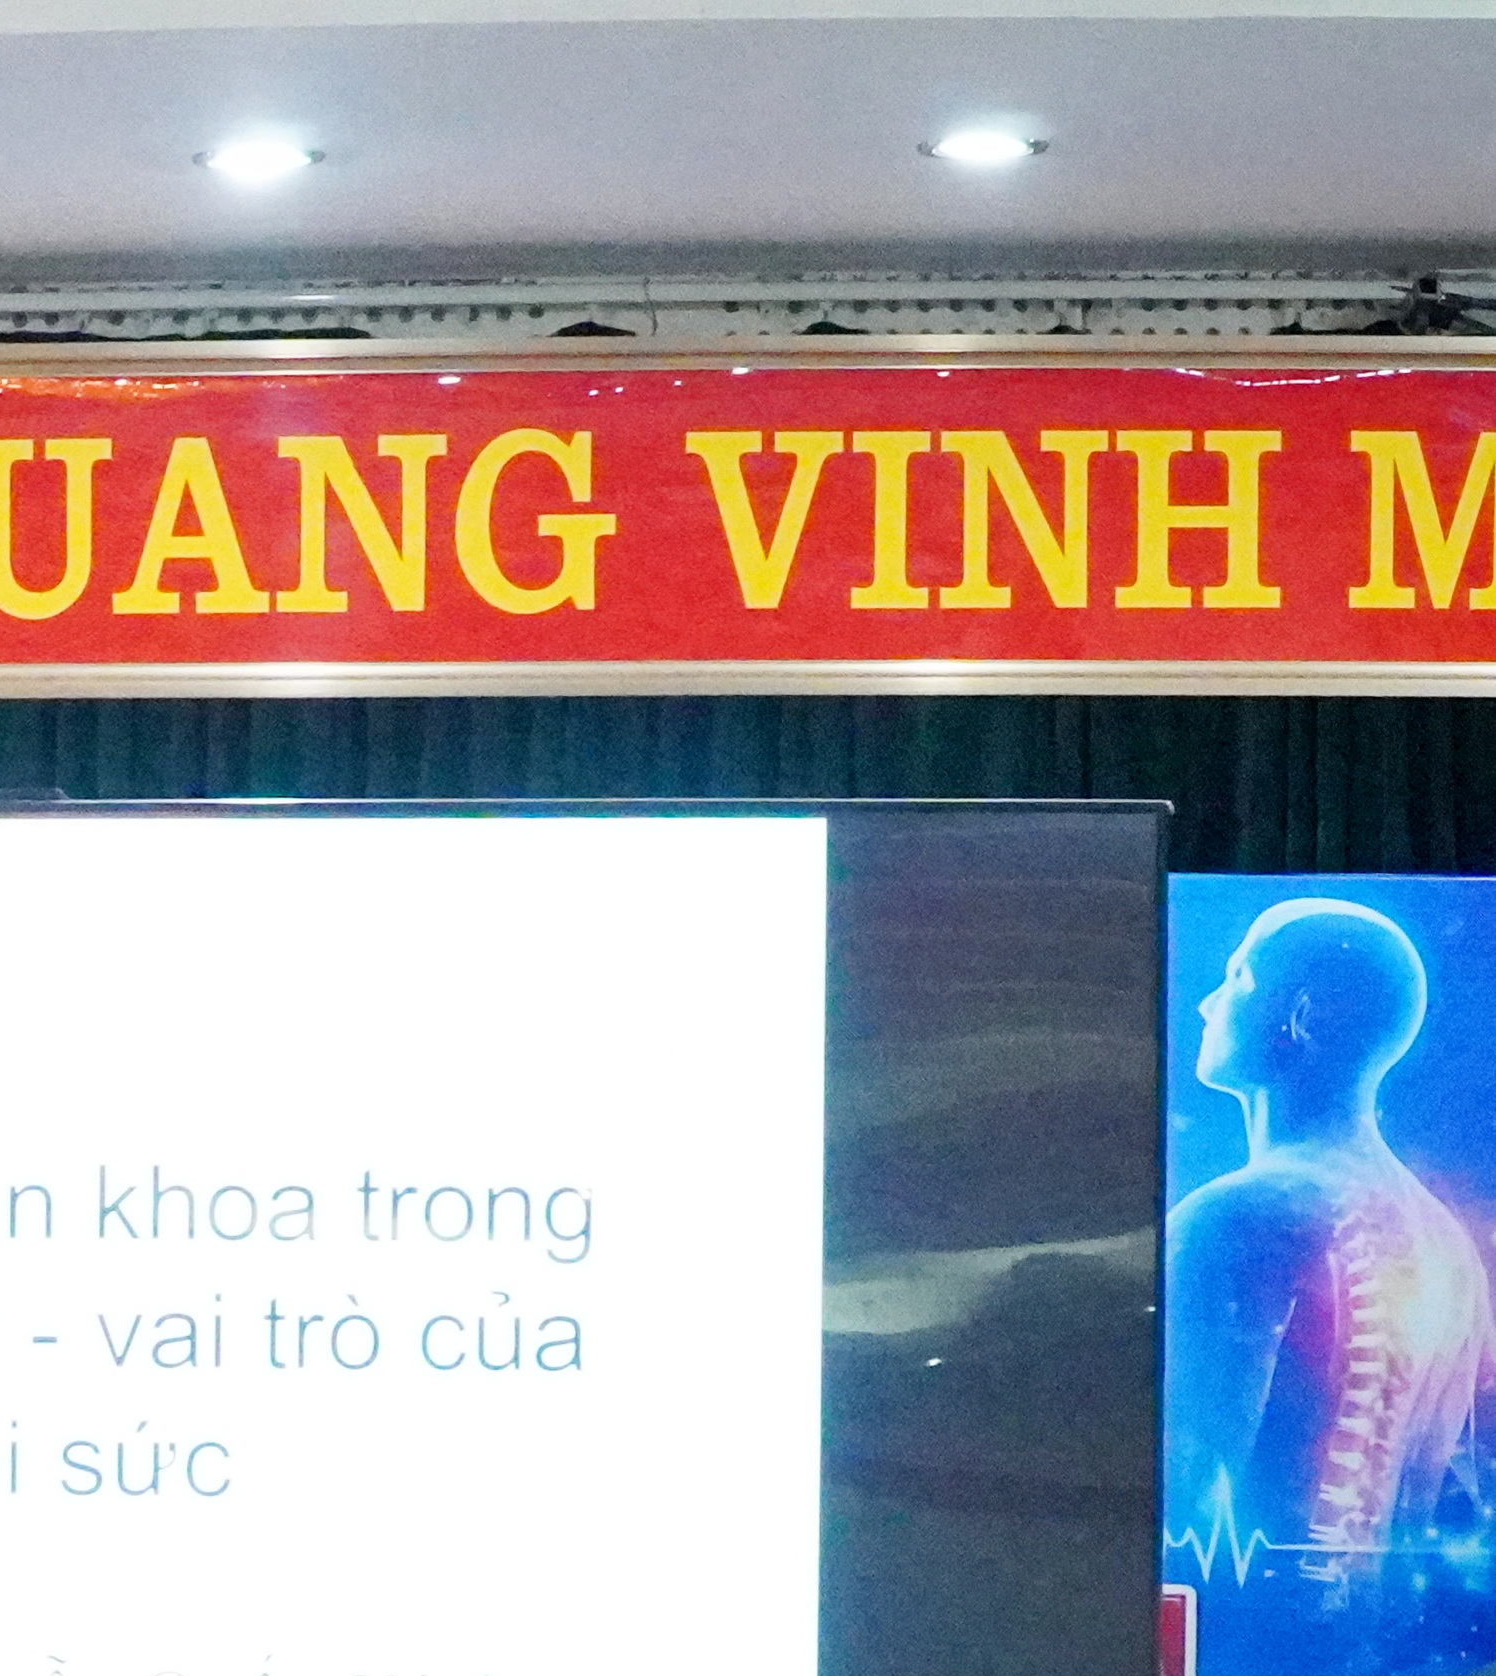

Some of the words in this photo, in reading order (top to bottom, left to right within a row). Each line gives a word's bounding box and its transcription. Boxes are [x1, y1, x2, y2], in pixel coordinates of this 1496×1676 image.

[684, 429, 1283, 611] VINH
[98, 1164, 318, 1244] khoa
[356, 1170, 595, 1265] trong
[31, 1334, 60, 1348] -
[97, 1293, 224, 1371] vai
[263, 1293, 383, 1373] trò
[420, 1290, 585, 1375] của
[60, 1420, 233, 1500] sức
